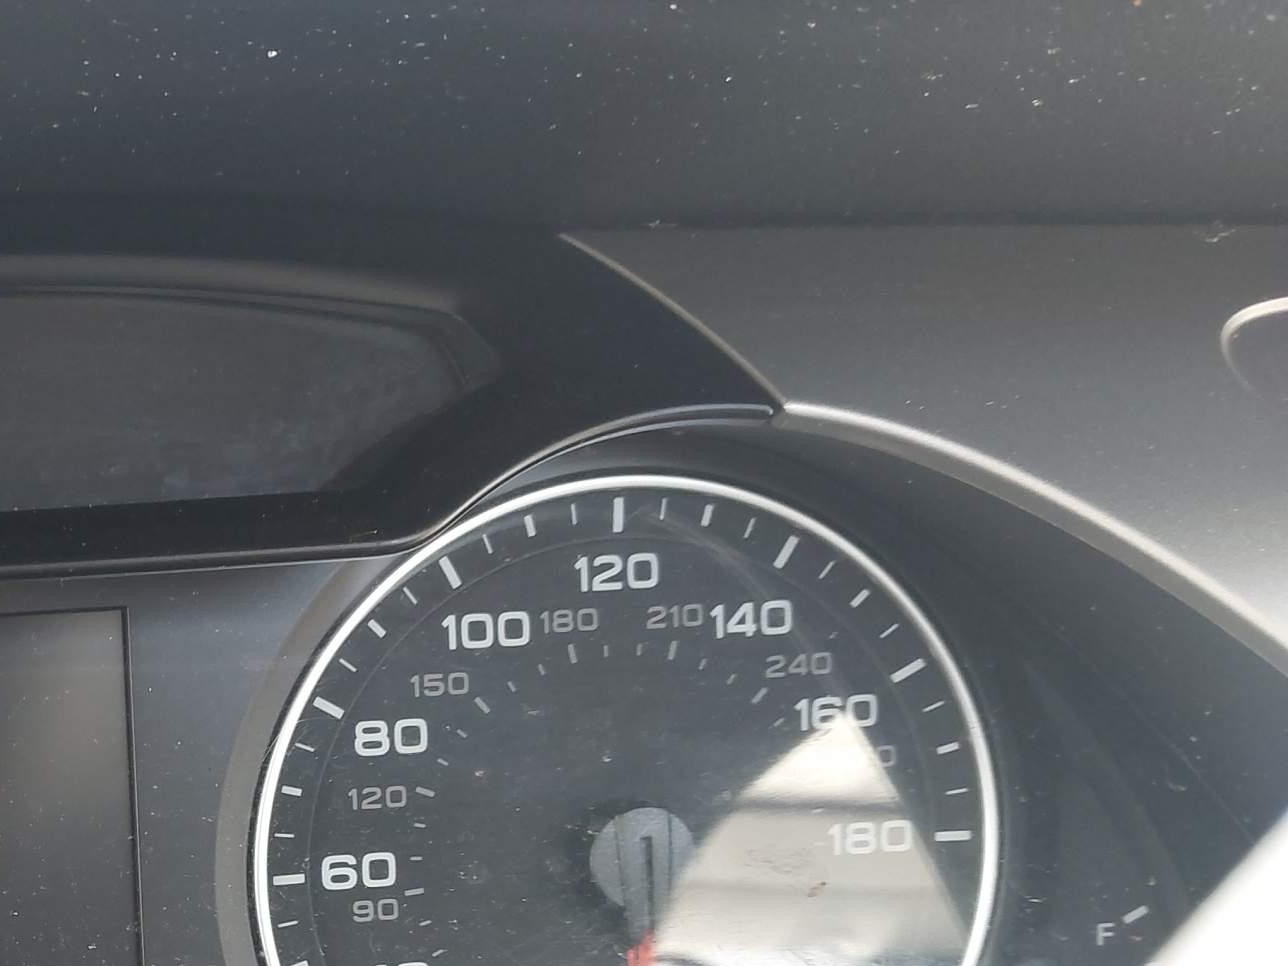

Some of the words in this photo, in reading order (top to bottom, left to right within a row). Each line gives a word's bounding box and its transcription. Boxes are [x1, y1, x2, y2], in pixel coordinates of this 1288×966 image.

[575, 552, 660, 592] 120
[442, 611, 530, 650] 100
[539, 607, 598, 634] 180
[646, 605, 703, 629] 210
[710, 600, 793, 638] 140
[765, 652, 832, 678] 240
[410, 672, 469, 697] 150
[795, 695, 878, 731] 160
[354, 718, 427, 757] 80
[347, 785, 408, 810] 120
[827, 819, 912, 855] 180
[321, 854, 397, 890] 60
[352, 899, 399, 922] 90
[1096, 922, 1116, 946] F
